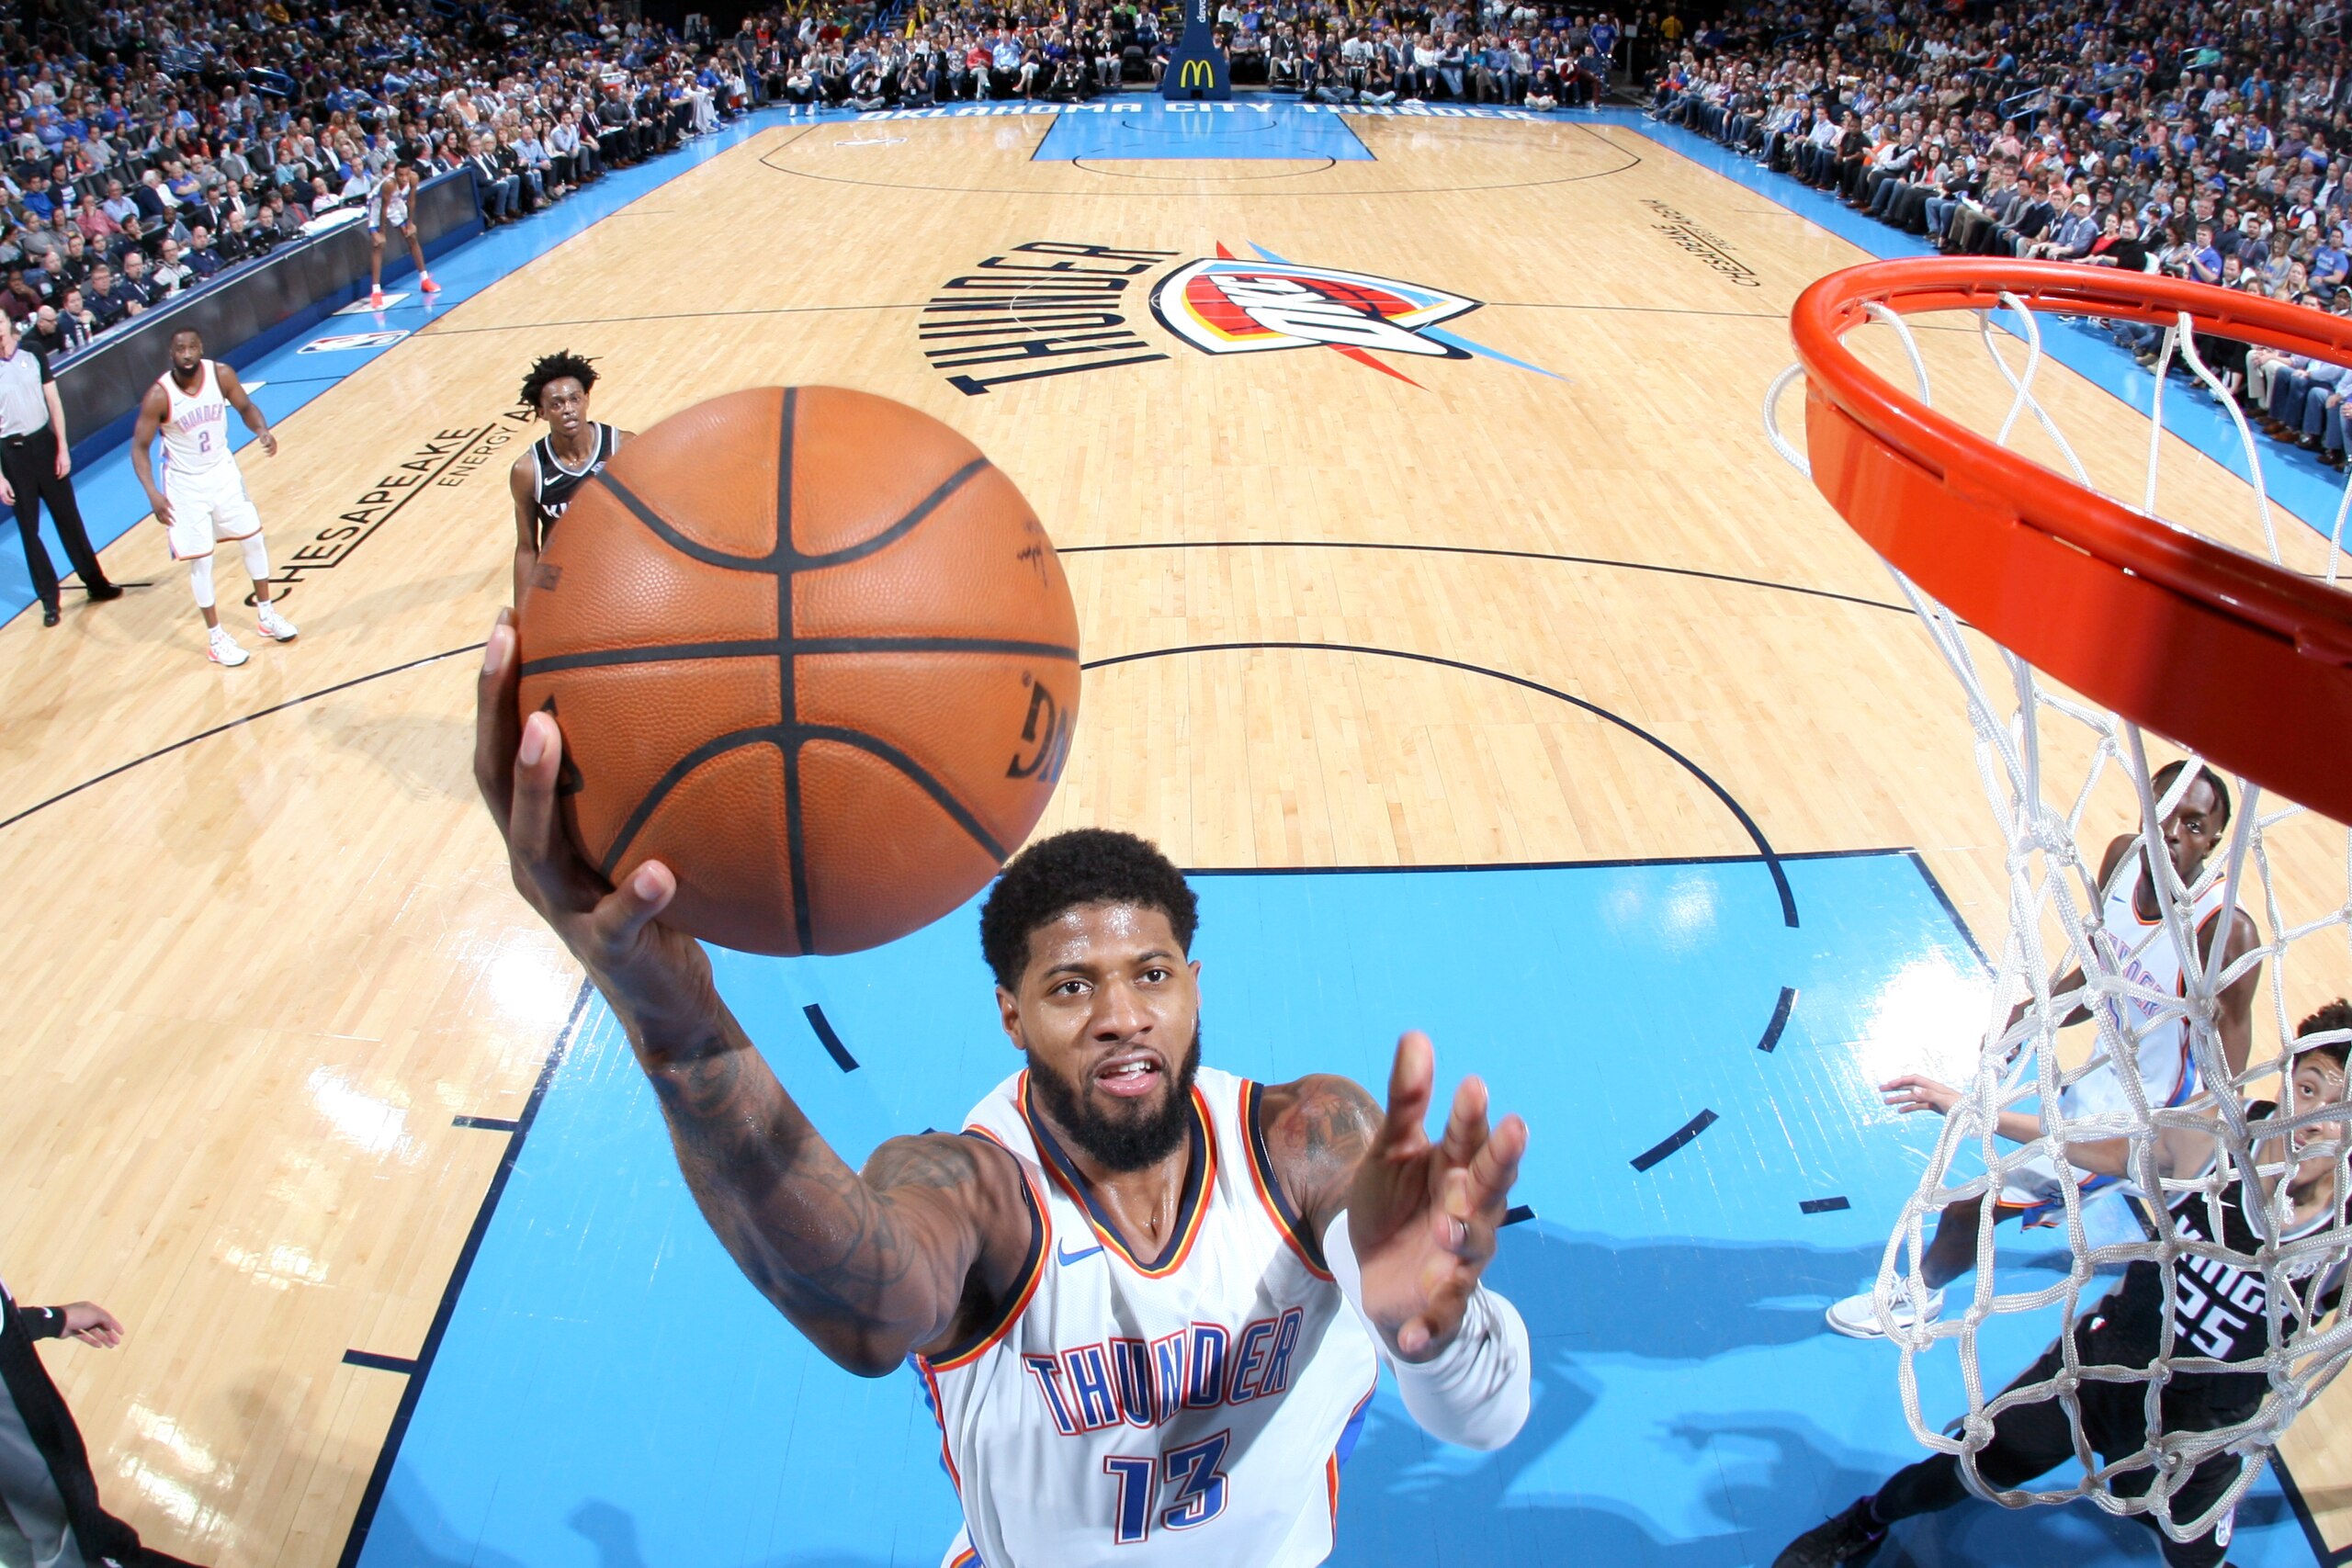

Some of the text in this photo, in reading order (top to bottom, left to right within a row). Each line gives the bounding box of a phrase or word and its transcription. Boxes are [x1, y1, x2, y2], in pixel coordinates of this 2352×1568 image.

[857, 103, 1539, 121] OKLAHOMA CITY THUNDER
[919, 241, 1182, 397] THUNDER
[175, 402, 223, 434] THUNDER
[198, 431, 211, 453] 2
[436, 426, 519, 488] ENERGY
[244, 427, 481, 608] CHESAPEAKE
[2160, 1273, 2248, 1359] 25
[1021, 1305, 1304, 1437] THUNDER
[1102, 1427, 1231, 1546] 13
